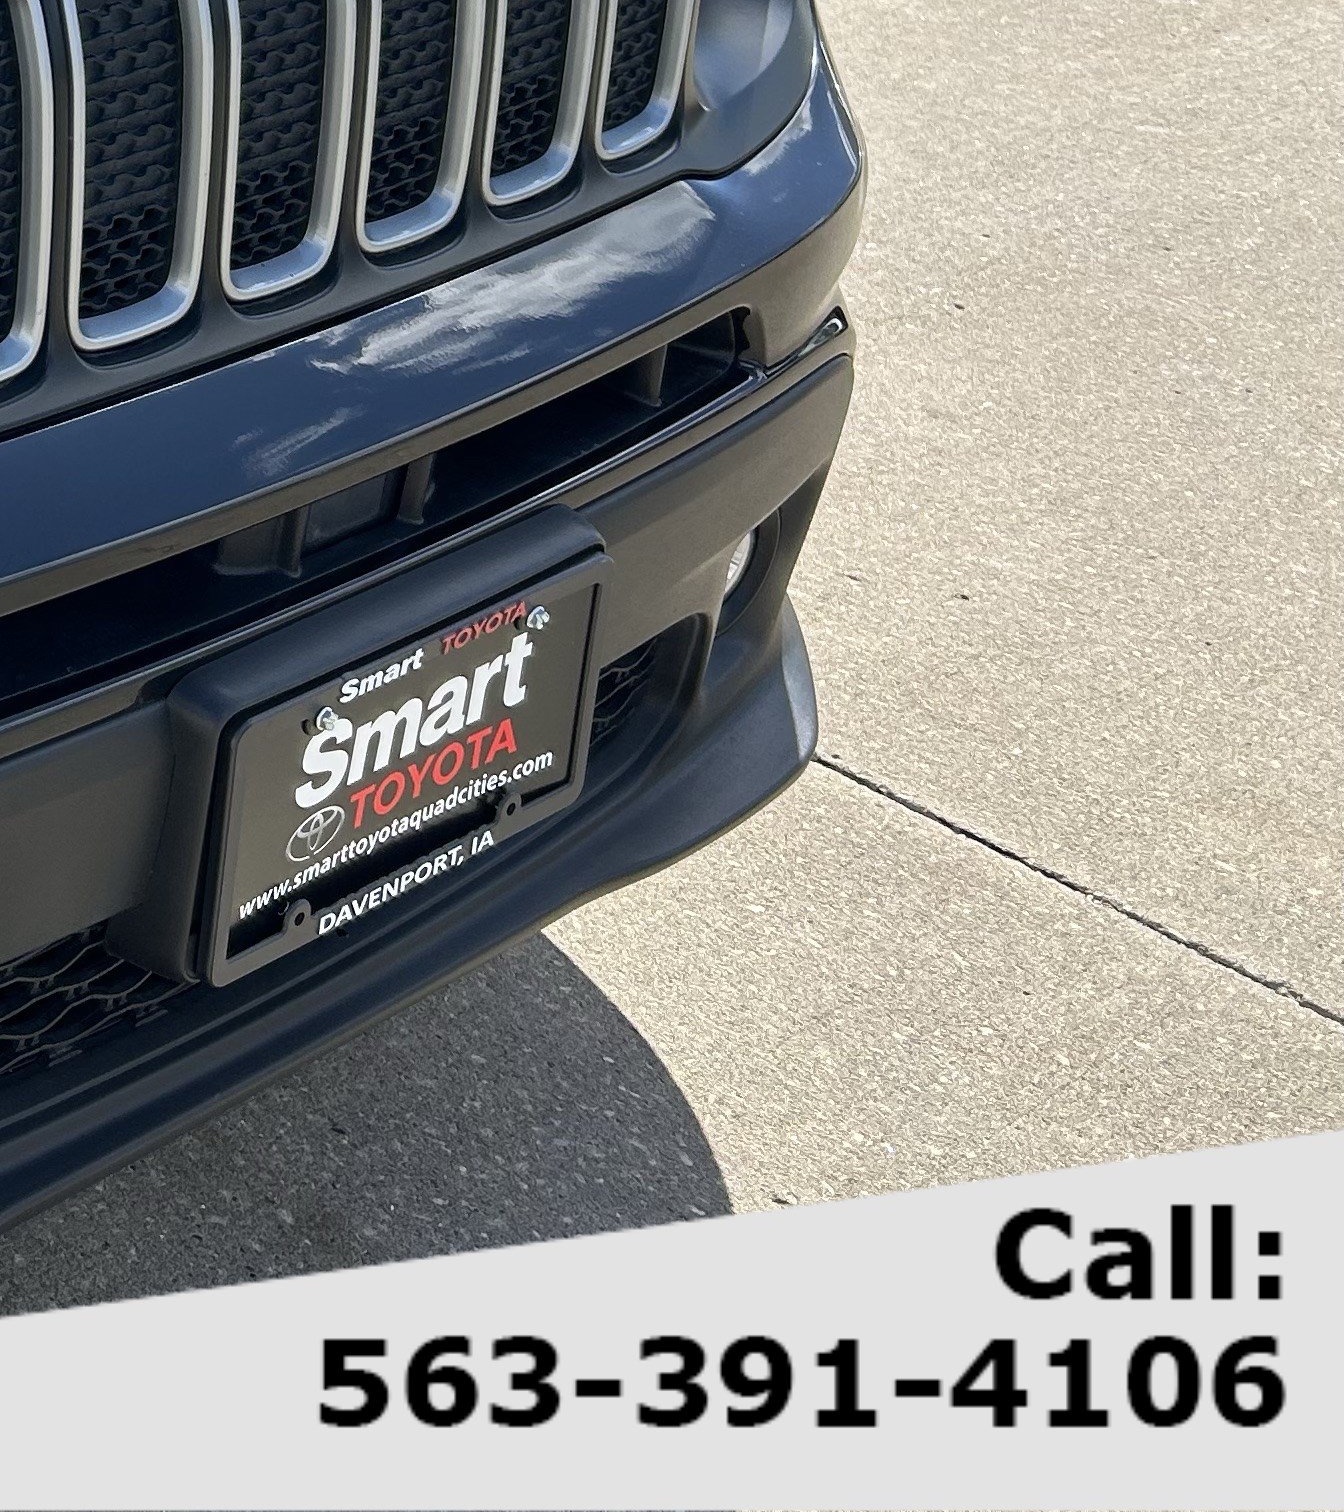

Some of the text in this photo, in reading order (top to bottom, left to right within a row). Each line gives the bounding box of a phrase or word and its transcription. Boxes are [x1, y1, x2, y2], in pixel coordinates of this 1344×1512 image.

[339, 600, 528, 704] Smart TOYOTA
[294, 631, 533, 809] Smart
[349, 718, 518, 829] TOYOTA
[238, 750, 553, 921] www.smarttoyotaquadcities.com
[317, 829, 495, 935] DAVENPORT, IA
